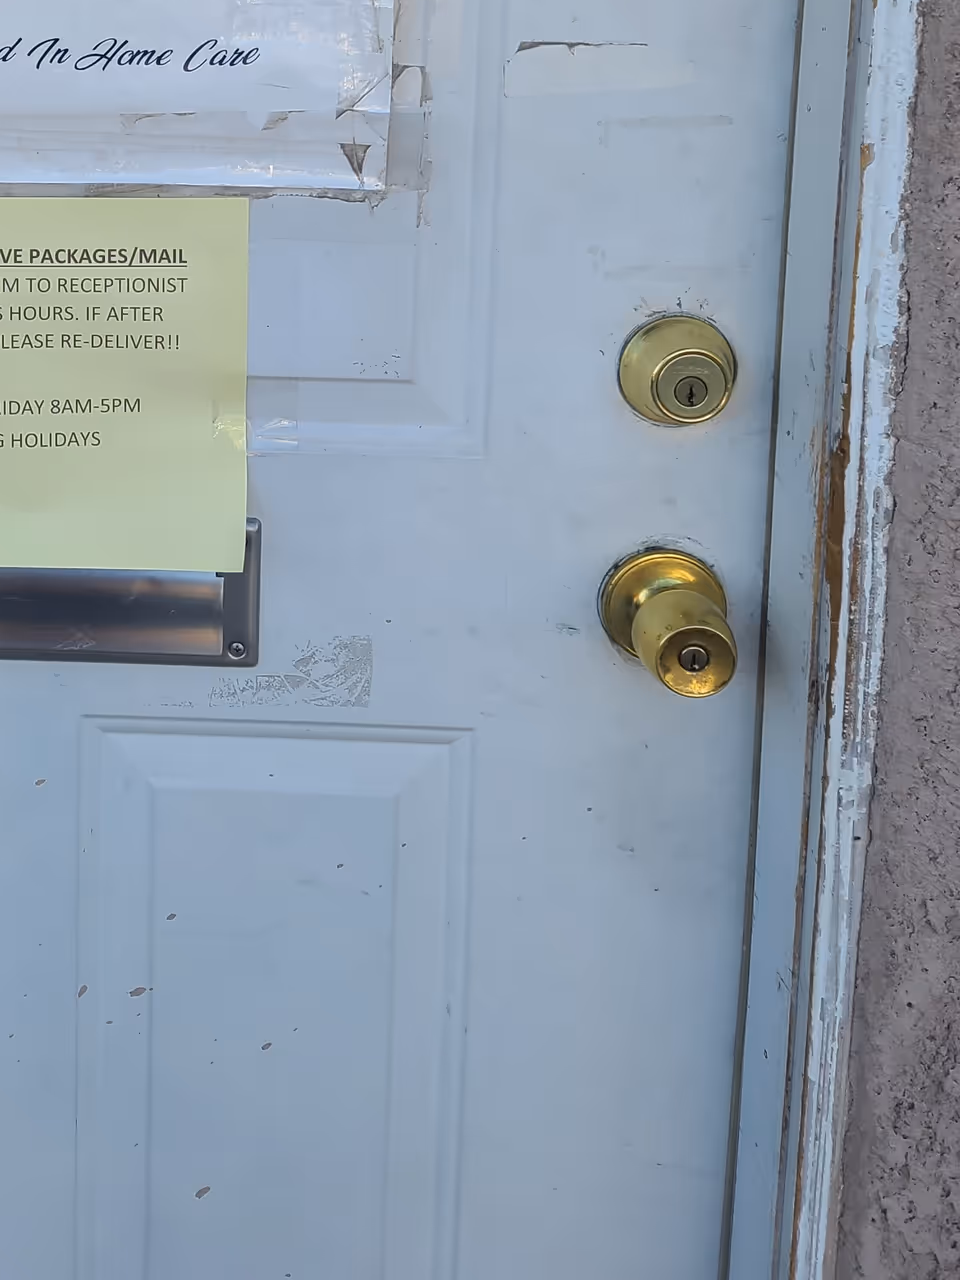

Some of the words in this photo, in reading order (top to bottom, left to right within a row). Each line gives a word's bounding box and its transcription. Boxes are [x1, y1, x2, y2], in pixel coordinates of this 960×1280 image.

[26, 37, 72, 70] In
[73, 38, 174, 71] Home
[183, 40, 262, 73] Care
[29, 247, 187, 265] PACKAGES/MAIL
[25, 277, 51, 293] TO
[57, 277, 188, 294] RECEPTIONIST
[9, 305, 79, 322] HOURS.
[85, 306, 101, 322] IF
[106, 306, 164, 322] AFTER
[61, 333, 181, 350] RE-DELIVER!!
[50, 397, 141, 414] 8AM-5PM
[10, 430, 101, 448] HOLIDAYS
